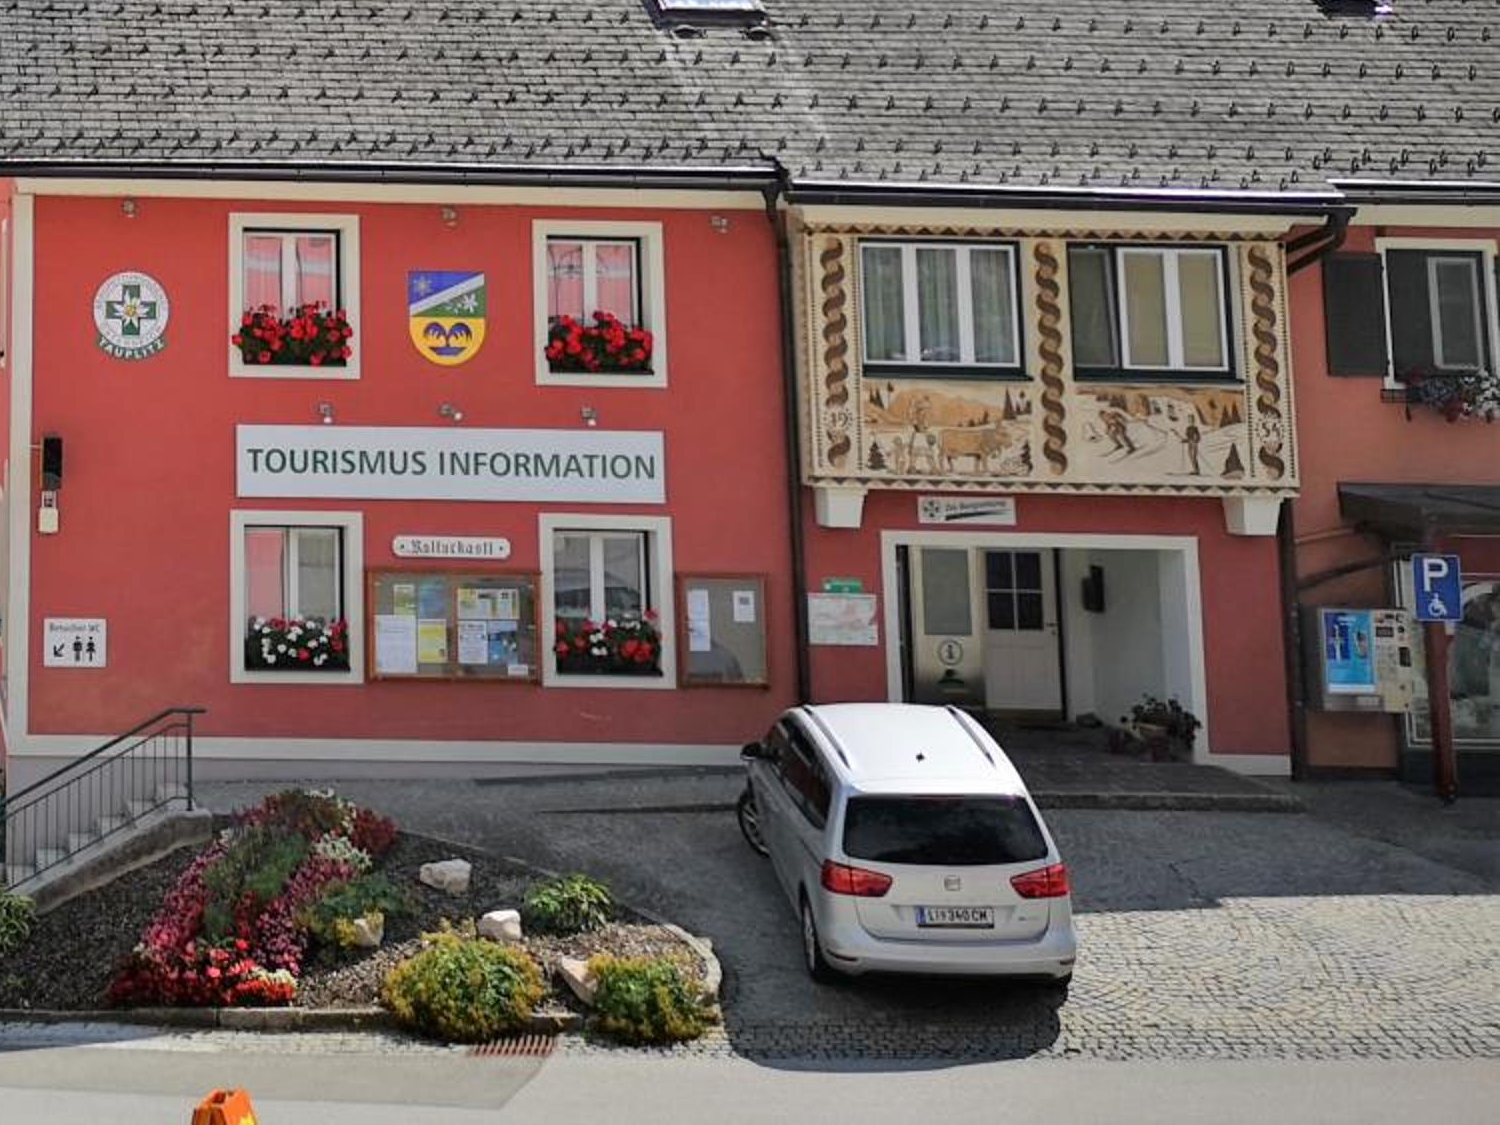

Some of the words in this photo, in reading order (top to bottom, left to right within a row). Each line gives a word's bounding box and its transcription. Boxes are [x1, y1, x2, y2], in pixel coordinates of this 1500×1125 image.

[99, 336, 164, 359] TAUPLITZ
[247, 448, 427, 475] TOURISMUS
[439, 451, 655, 479] INFORMATION
[1422, 558, 1448, 592] P
